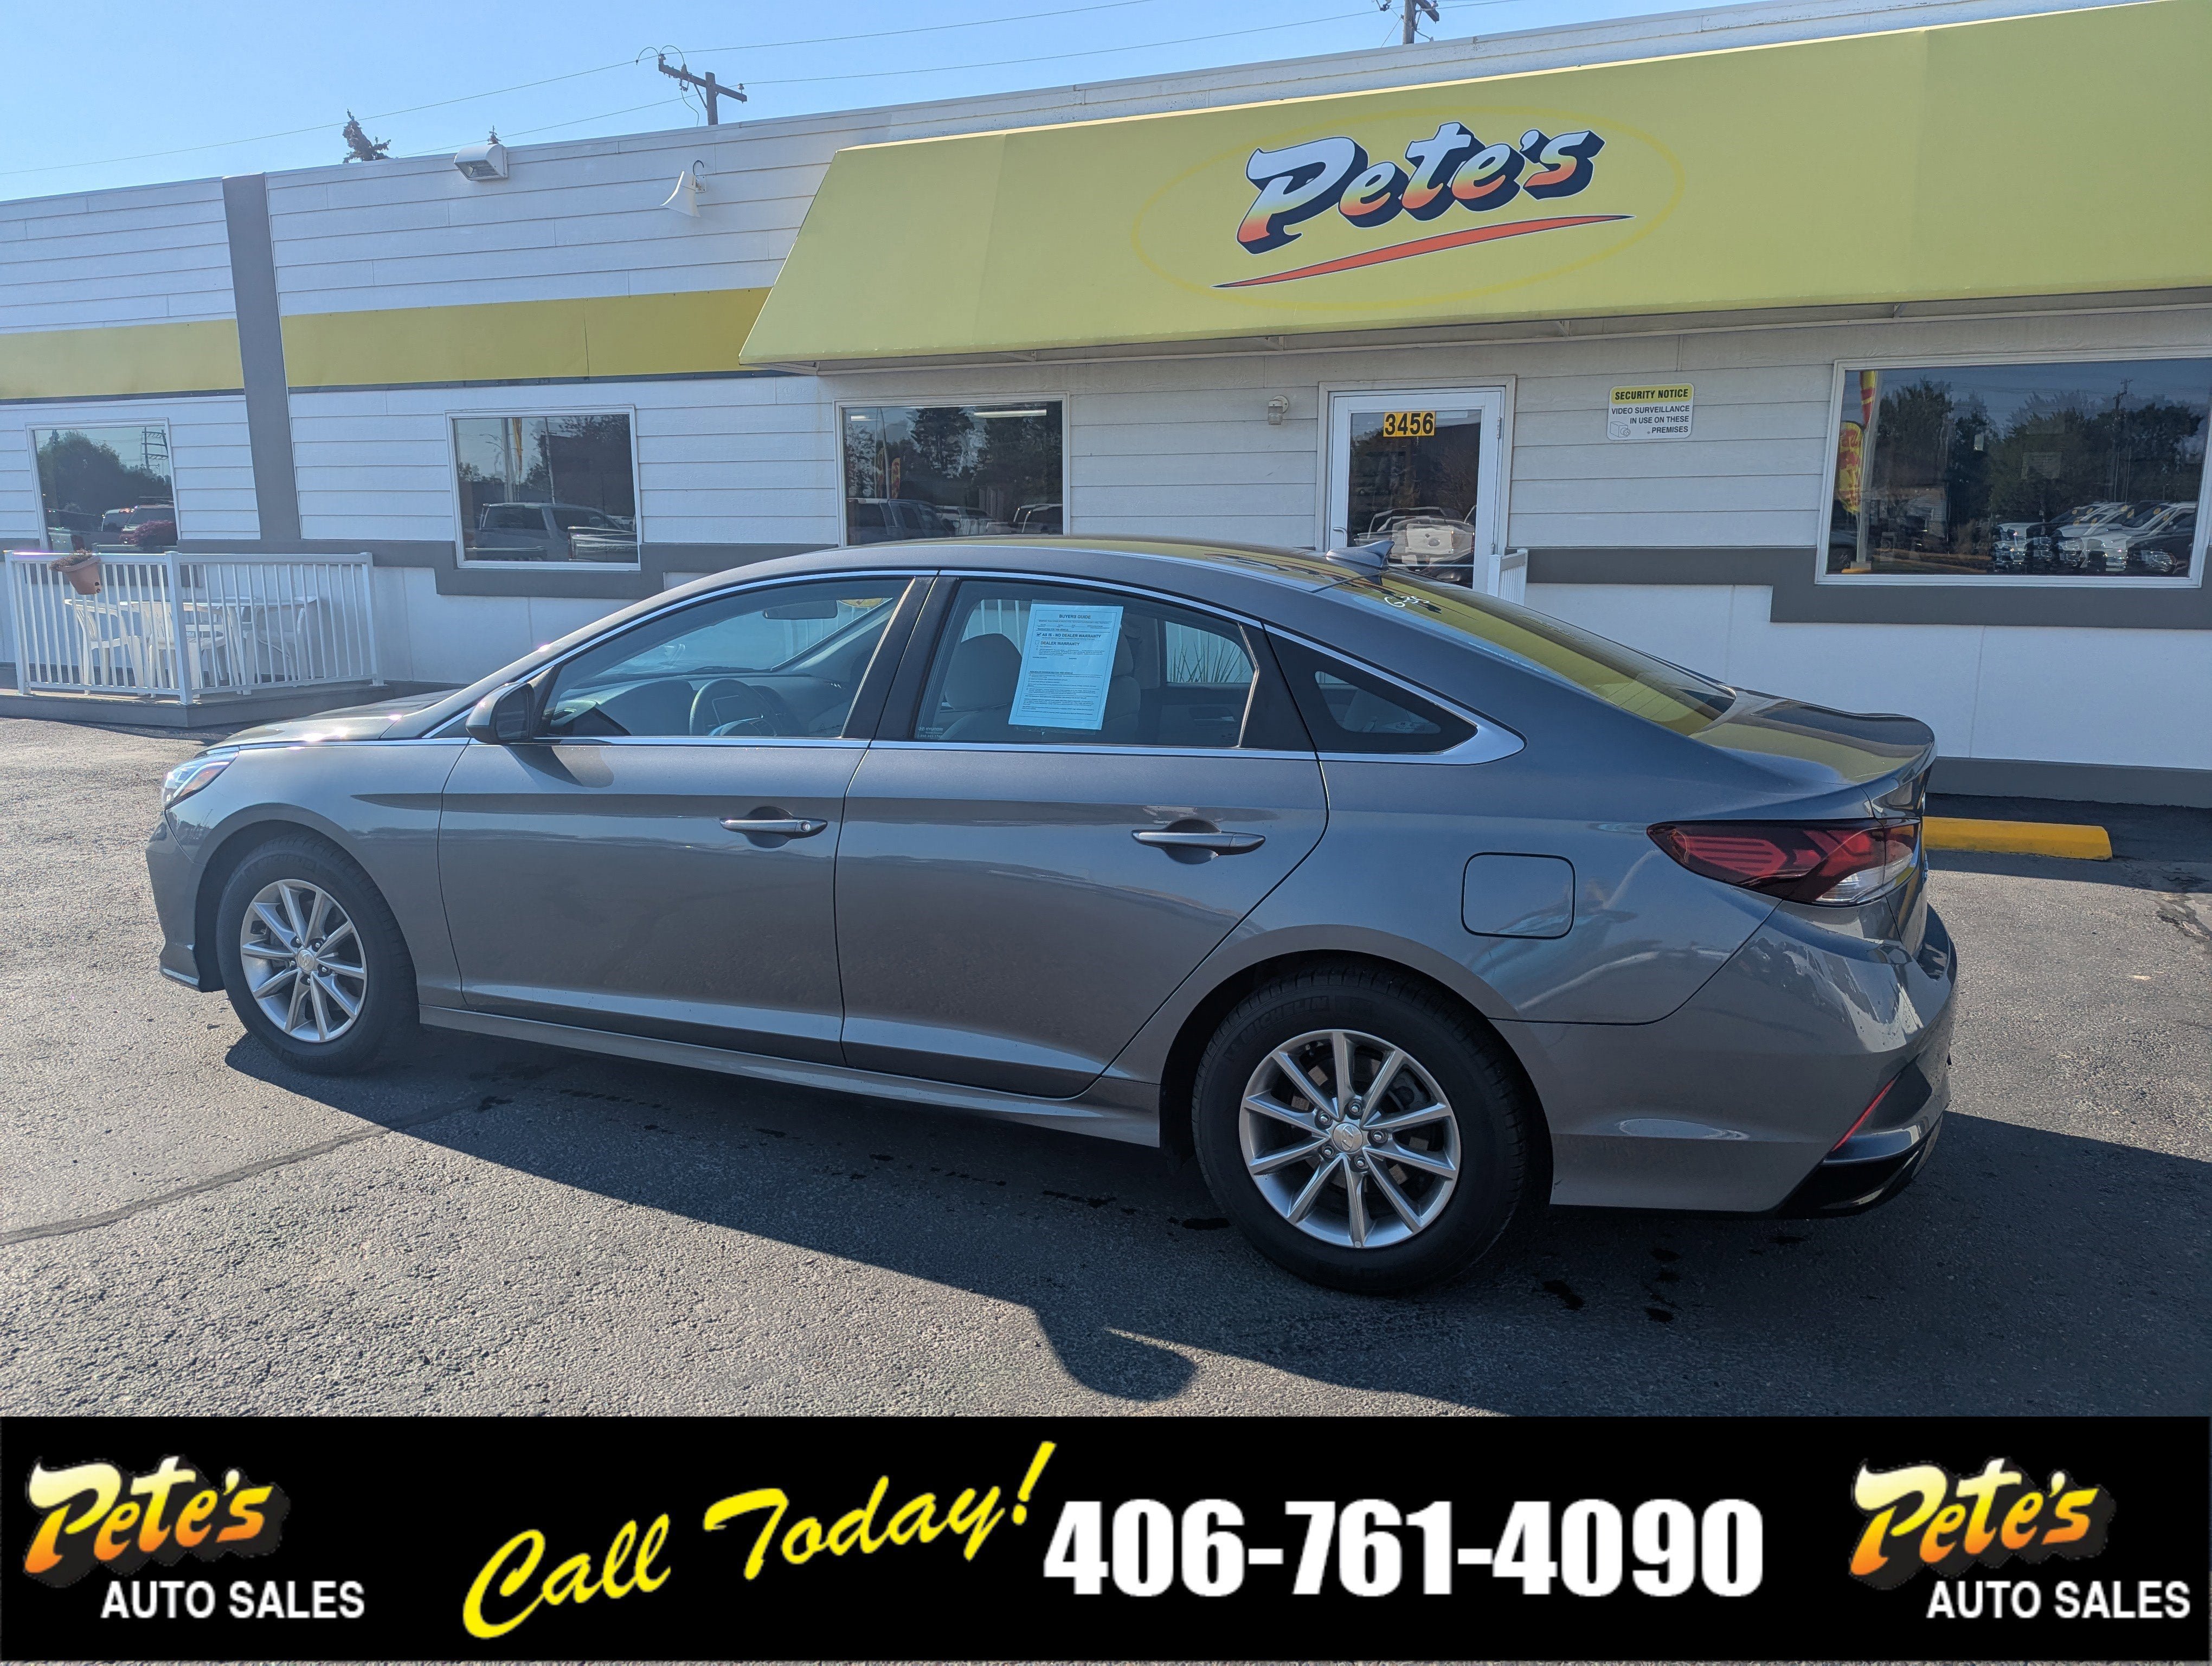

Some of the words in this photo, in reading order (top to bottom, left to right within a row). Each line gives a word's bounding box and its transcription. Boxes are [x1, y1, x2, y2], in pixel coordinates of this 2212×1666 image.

[1236, 121, 1606, 254] Pete's
[1615, 390, 1655, 400] SECURITY
[1658, 388, 1688, 398] NOTICE
[1635, 405, 1690, 414] SURVEILLANCE
[1385, 412, 1433, 435] 3456
